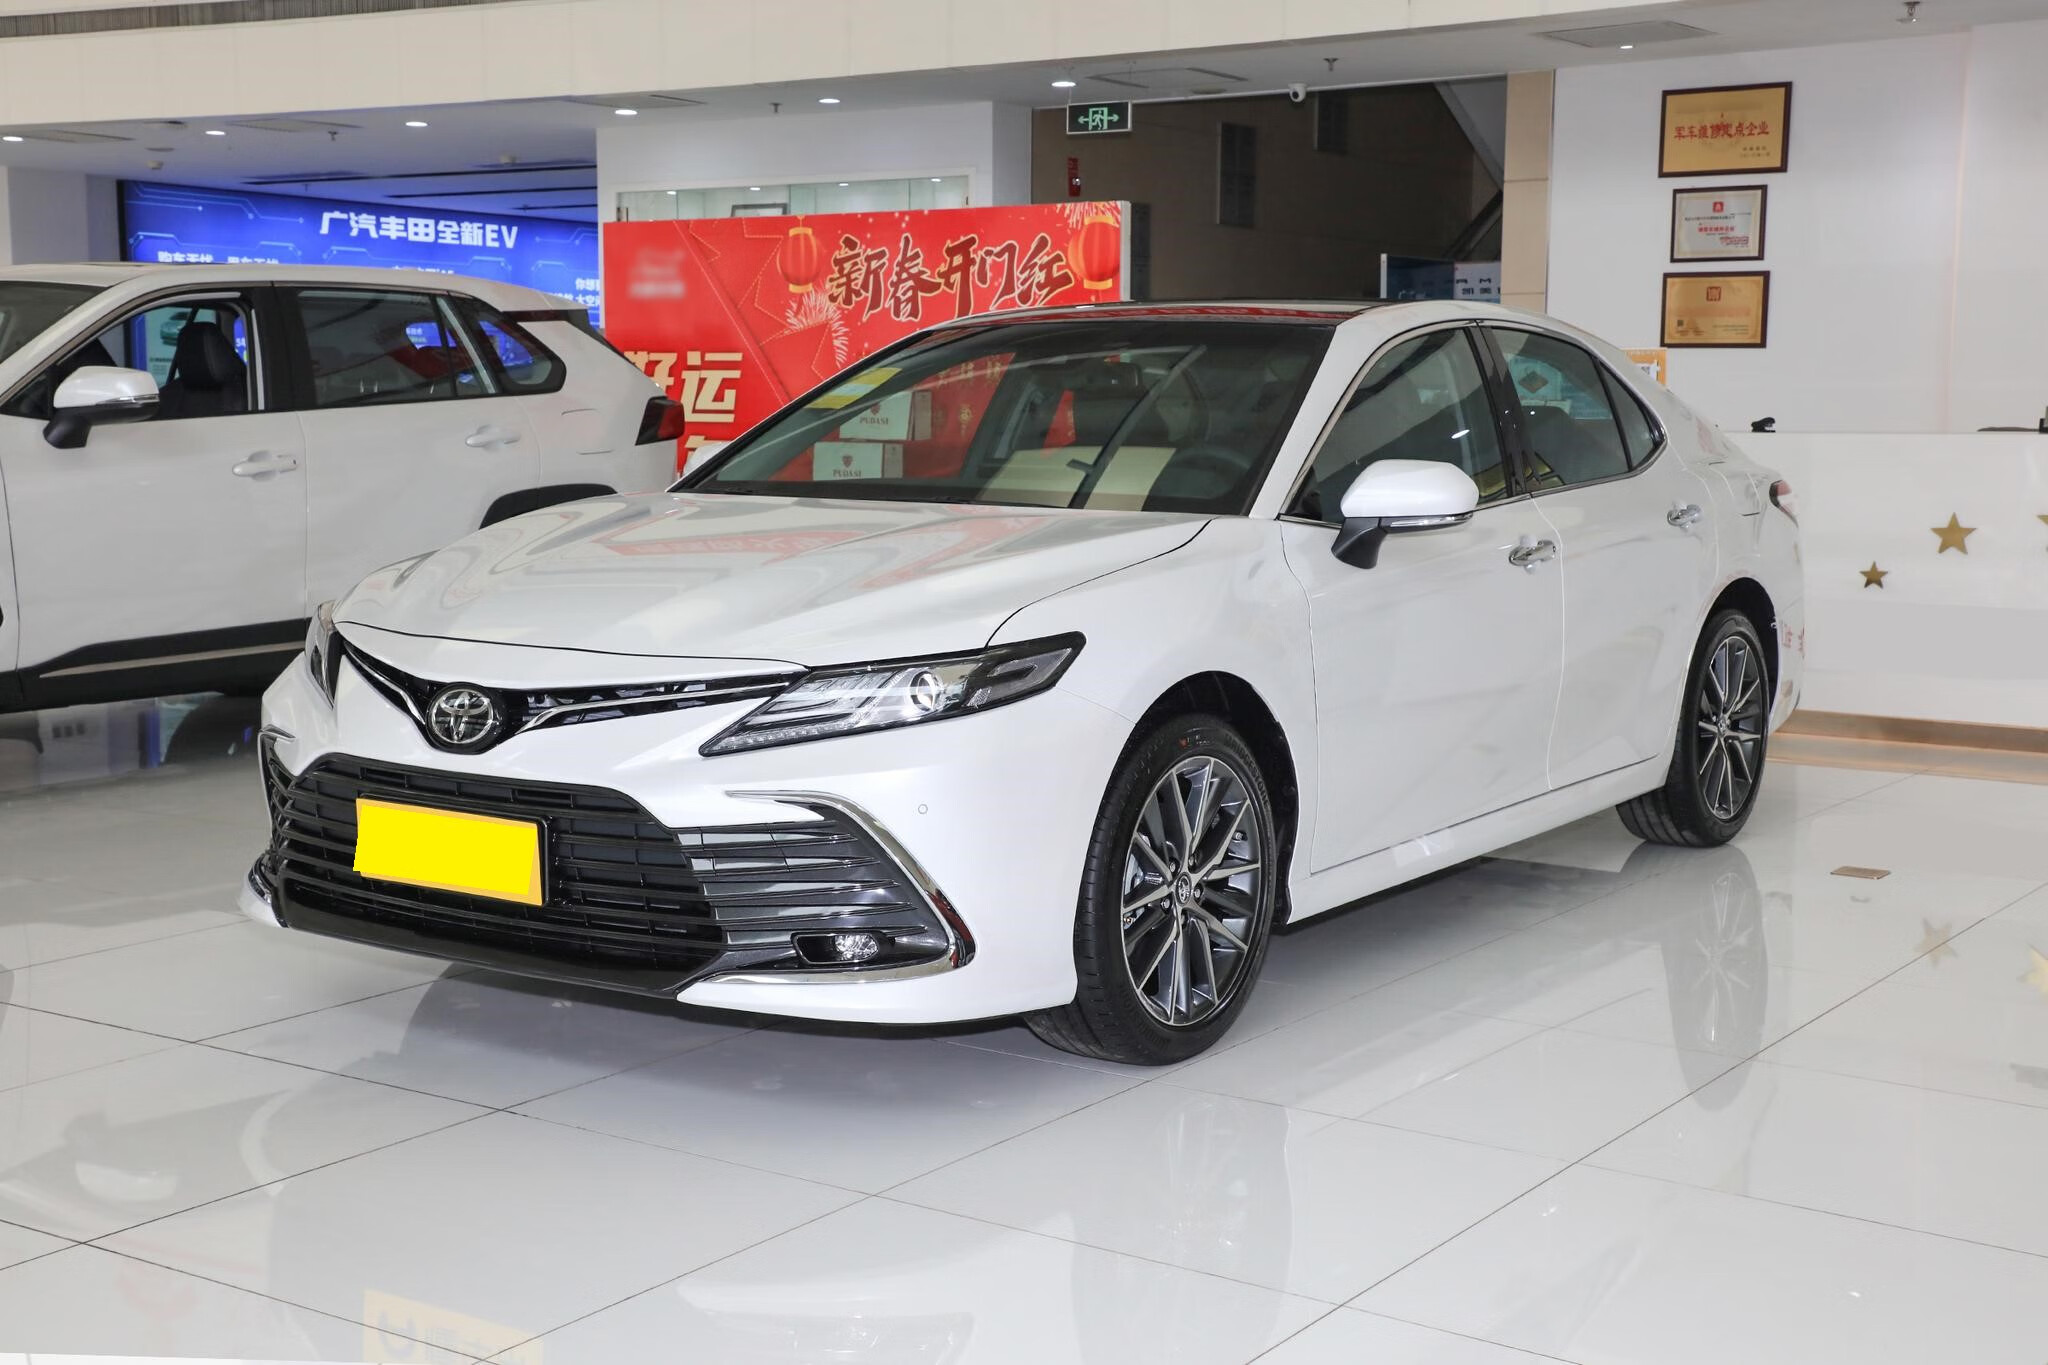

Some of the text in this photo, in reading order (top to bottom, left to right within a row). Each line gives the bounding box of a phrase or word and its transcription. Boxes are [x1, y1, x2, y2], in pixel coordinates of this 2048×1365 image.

[320, 210, 519, 249] 广汽丰田全新EV
[825, 232, 1075, 322] 新春开门红
